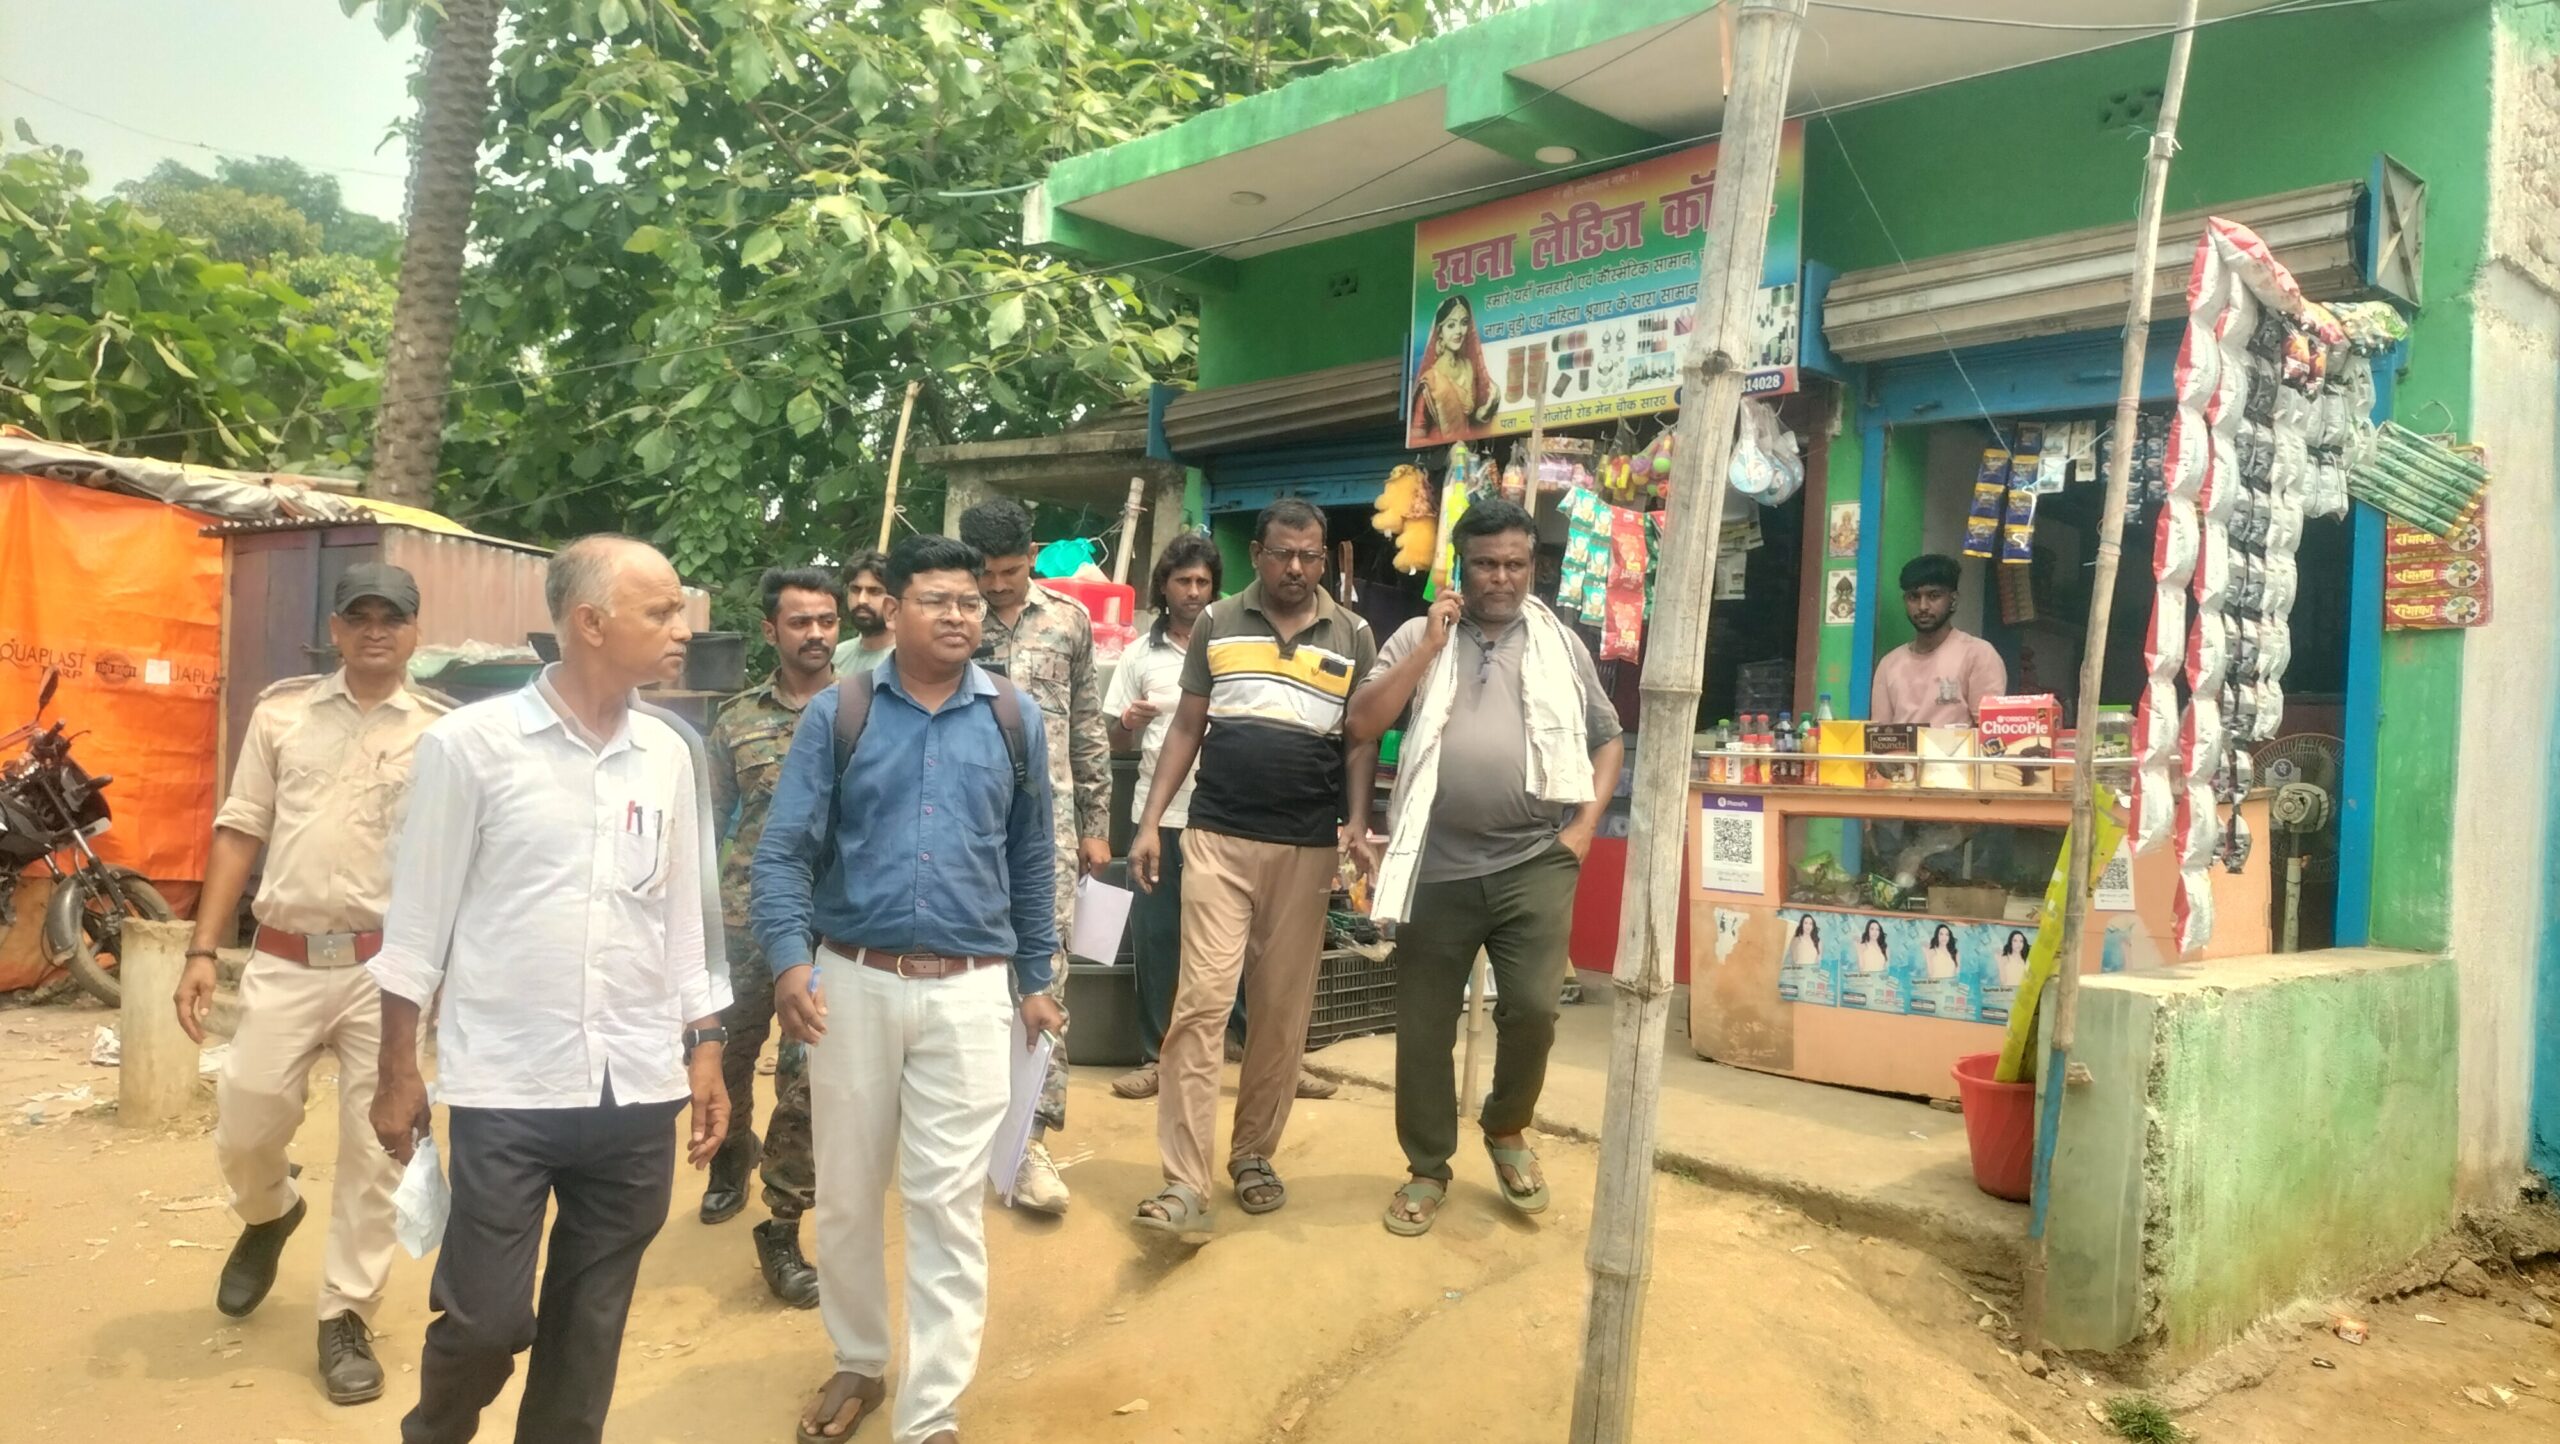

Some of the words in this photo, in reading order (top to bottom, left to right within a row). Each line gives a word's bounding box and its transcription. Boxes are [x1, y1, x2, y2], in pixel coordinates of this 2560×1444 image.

[1432, 233, 1518, 291] रचना
[1529, 200, 1646, 270] लेडिज
[1484, 286, 1511, 311] हमारे
[1546, 304, 1580, 326] महिला
[1616, 291, 1629, 312] के
[1630, 291, 1656, 310] सारा
[1660, 282, 1699, 304] सामान
[1744, 374, 1781, 392] 14028
[1500, 417, 1517, 428] पता
[1576, 403, 1592, 418] रोड
[1616, 397, 1637, 411] चौक
[40, 665, 83, 679] TRP
[1981, 720, 2048, 735] ChocoPie
